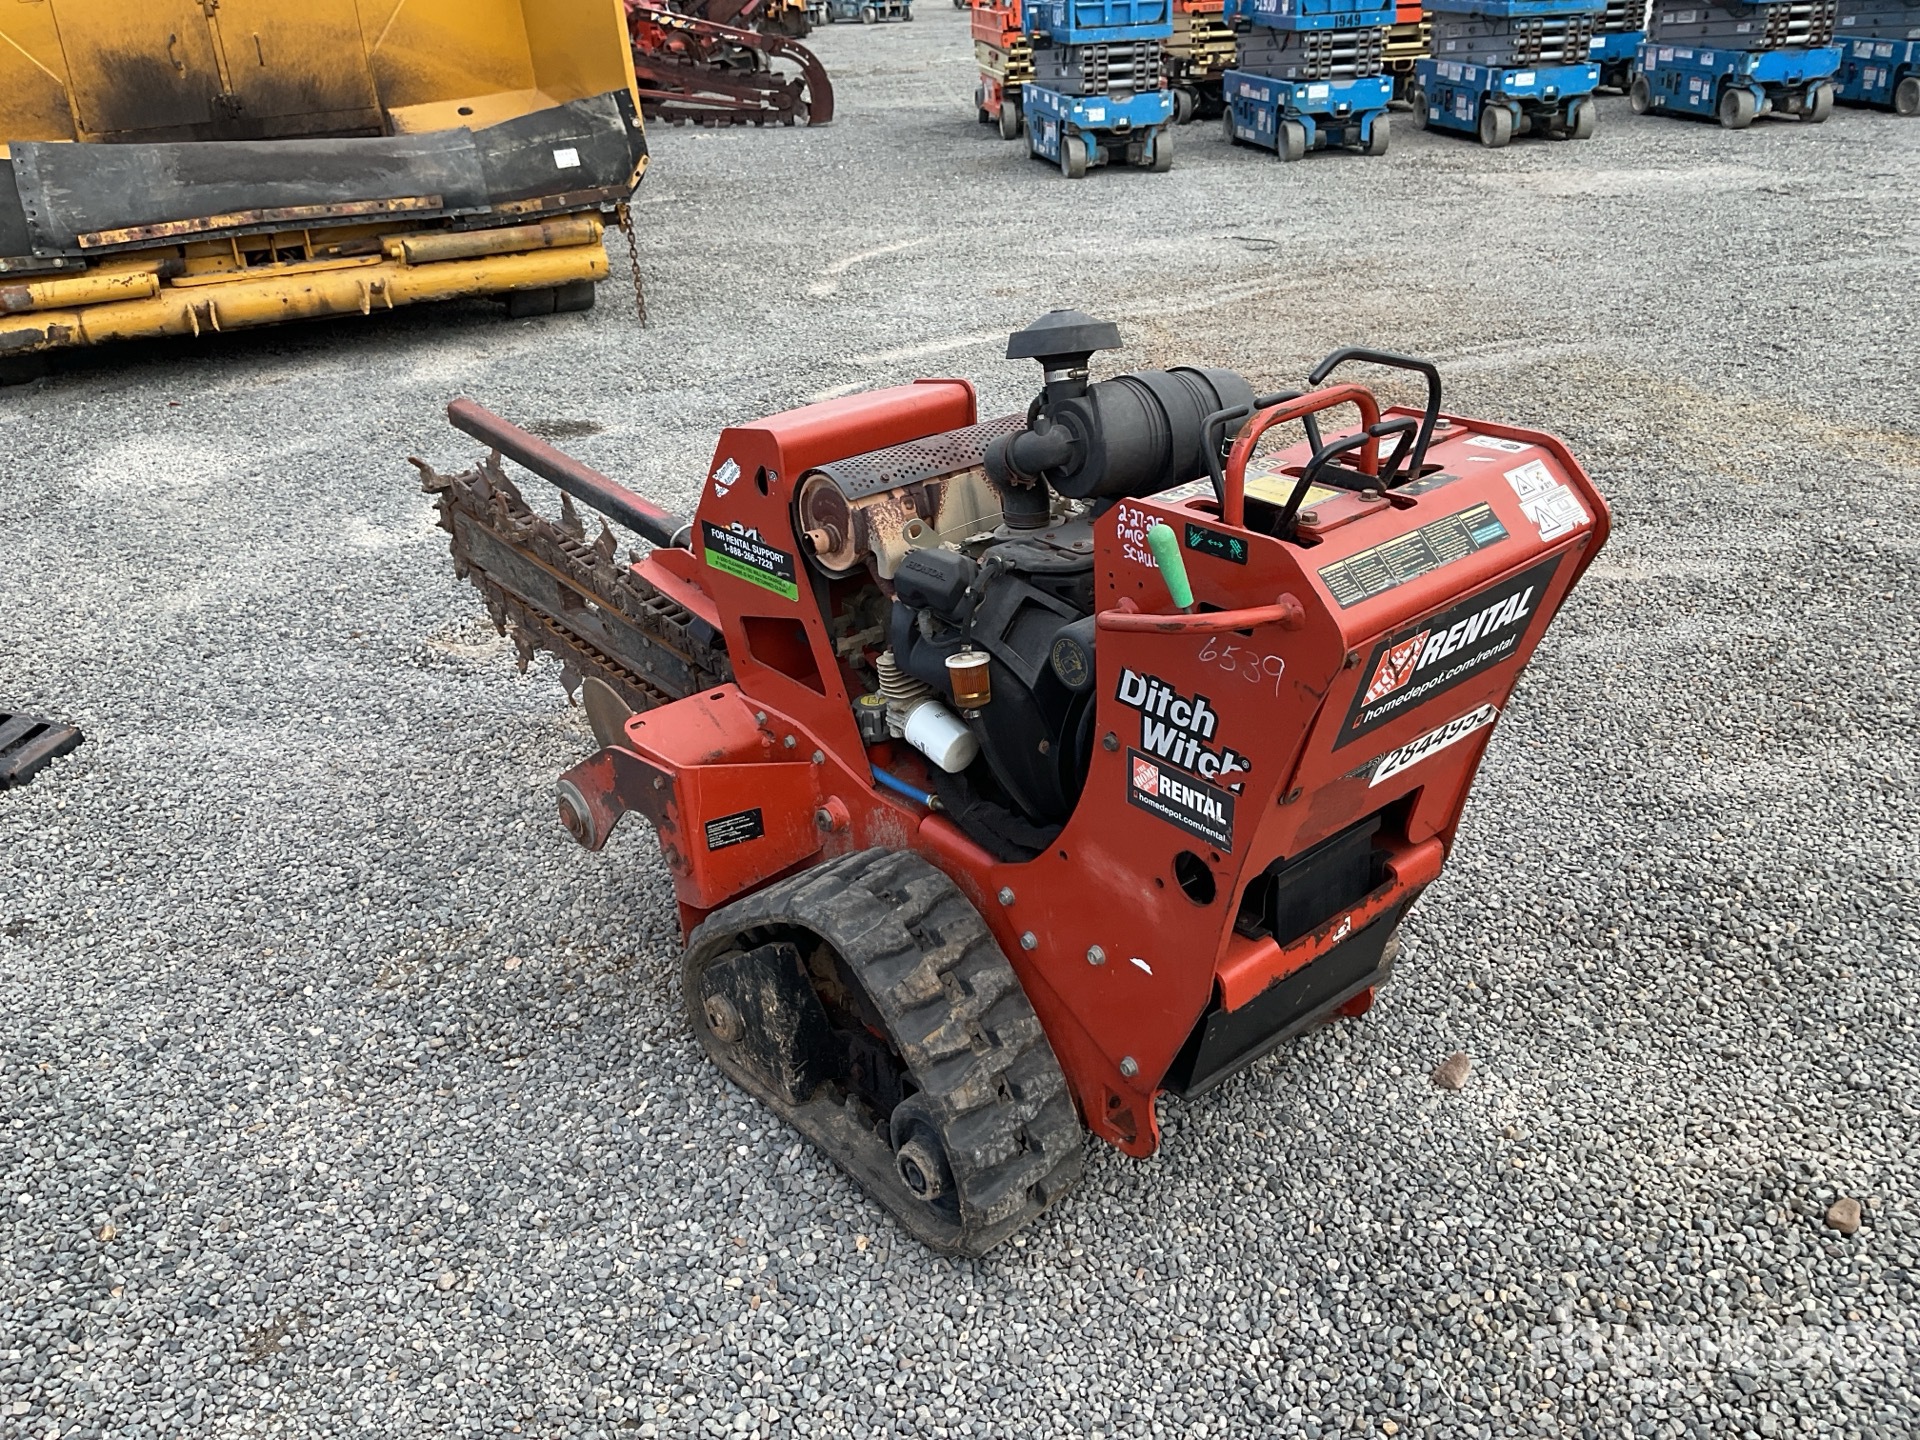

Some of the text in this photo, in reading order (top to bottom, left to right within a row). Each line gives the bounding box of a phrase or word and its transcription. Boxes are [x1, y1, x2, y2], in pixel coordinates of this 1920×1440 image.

[1334, 13, 1361, 28] 1949
[710, 528, 785, 564] FOR RENTAL SUPPORT
[1415, 585, 1535, 672] RENTAL
[1198, 636, 1285, 699] 6539
[1362, 634, 1517, 724] homedepot.com/rental
[1118, 668, 1216, 738] Ditch
[1134, 766, 1158, 788] HOME
[1143, 715, 1243, 790] Witch
[1138, 792, 1227, 843] homedepot.com/rental
[1159, 773, 1227, 826] RENTAL
